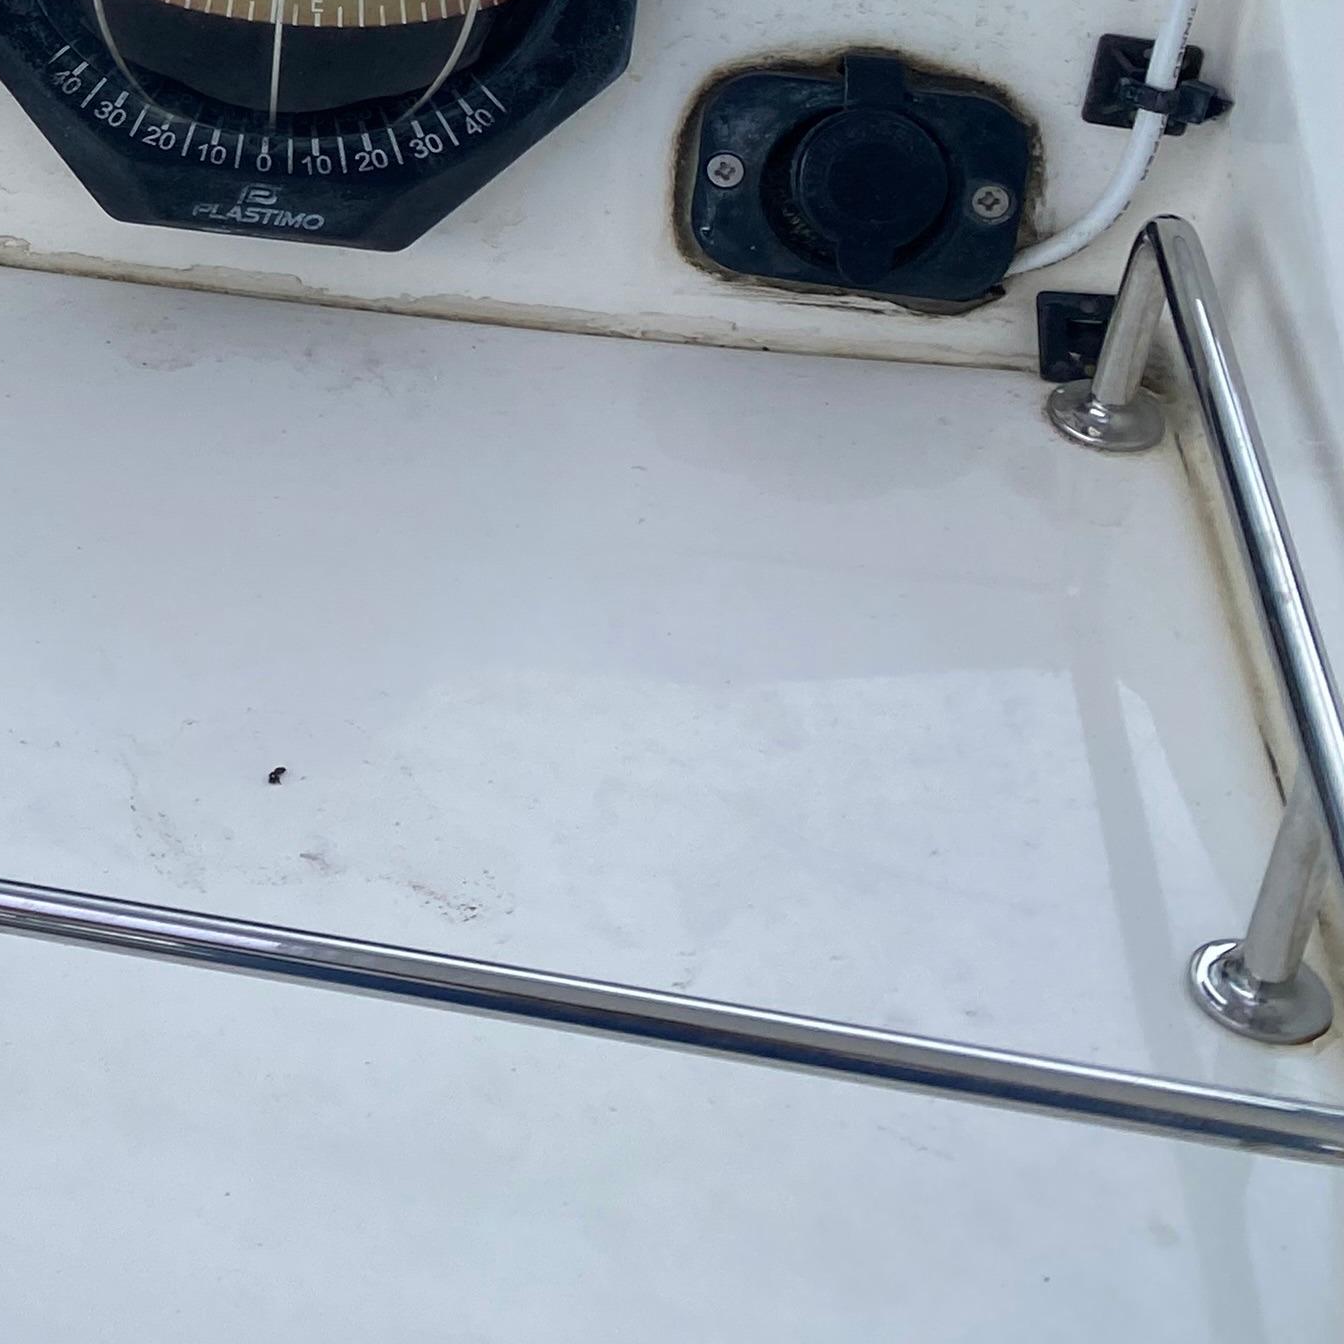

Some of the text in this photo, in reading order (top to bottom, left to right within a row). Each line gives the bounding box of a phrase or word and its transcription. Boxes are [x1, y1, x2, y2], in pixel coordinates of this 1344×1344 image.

[94, 101, 127, 127] 30
[142, 126, 176, 150] 20
[198, 144, 226, 165] 10
[256, 154, 272, 172] 0
[301, 155, 332, 175] 10
[355, 149, 389, 172] 20
[409, 133, 444, 159] 30
[465, 108, 495, 135] 40
[192, 203, 325, 231] PLASTIMO
